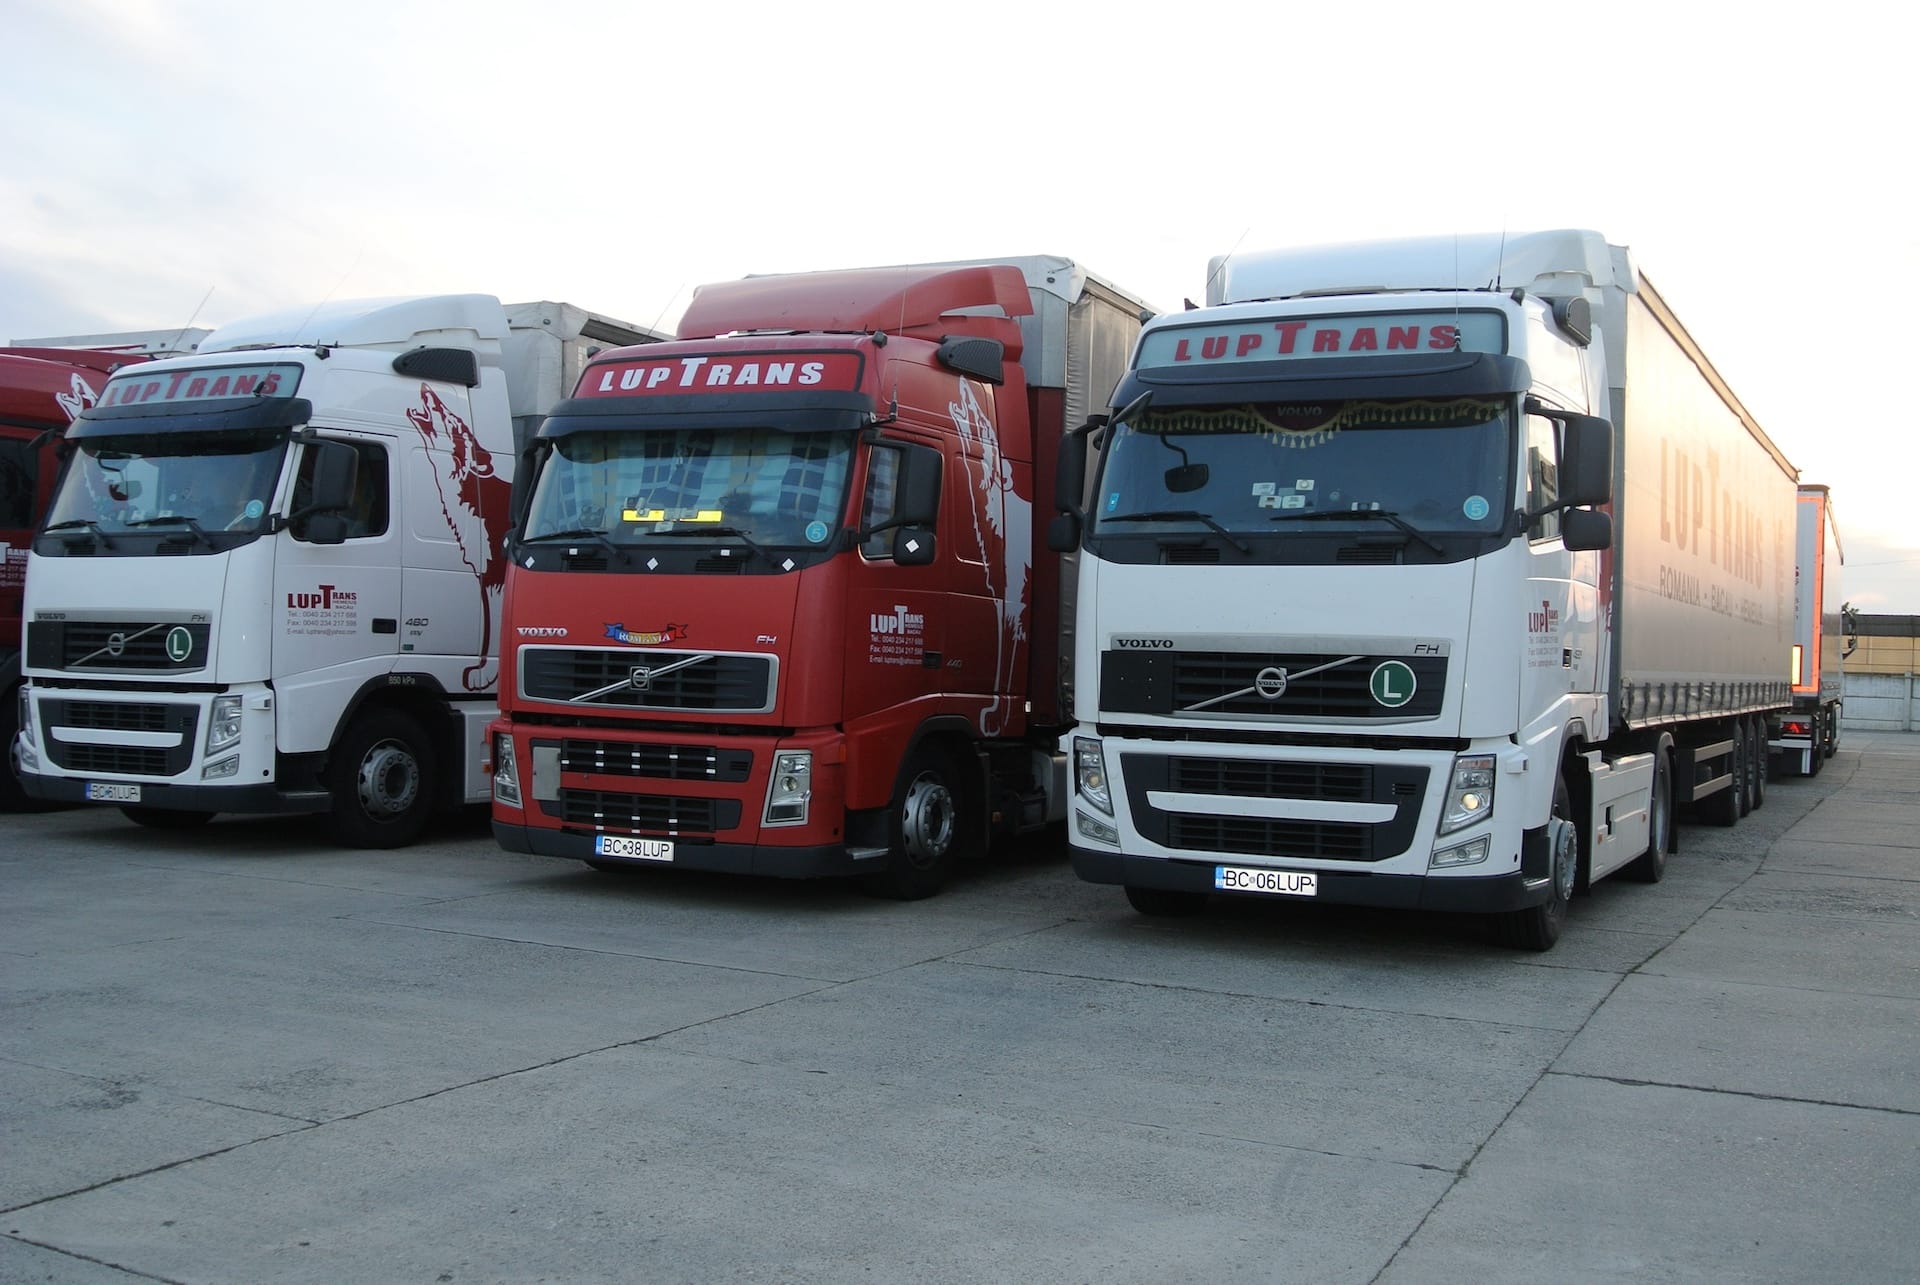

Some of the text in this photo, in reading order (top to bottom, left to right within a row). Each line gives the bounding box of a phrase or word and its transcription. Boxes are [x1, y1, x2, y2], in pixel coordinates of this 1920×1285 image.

[599, 357, 824, 391] LUPTRANS
[1277, 406, 1322, 416] VOLVO
[191, 614, 206, 622] FH
[517, 627, 568, 637] VOLVO
[172, 634, 184, 655] L
[756, 634, 777, 645] FH
[1117, 639, 1174, 649] VOLVO
[1414, 644, 1440, 655] FH
[1383, 670, 1402, 699] L
